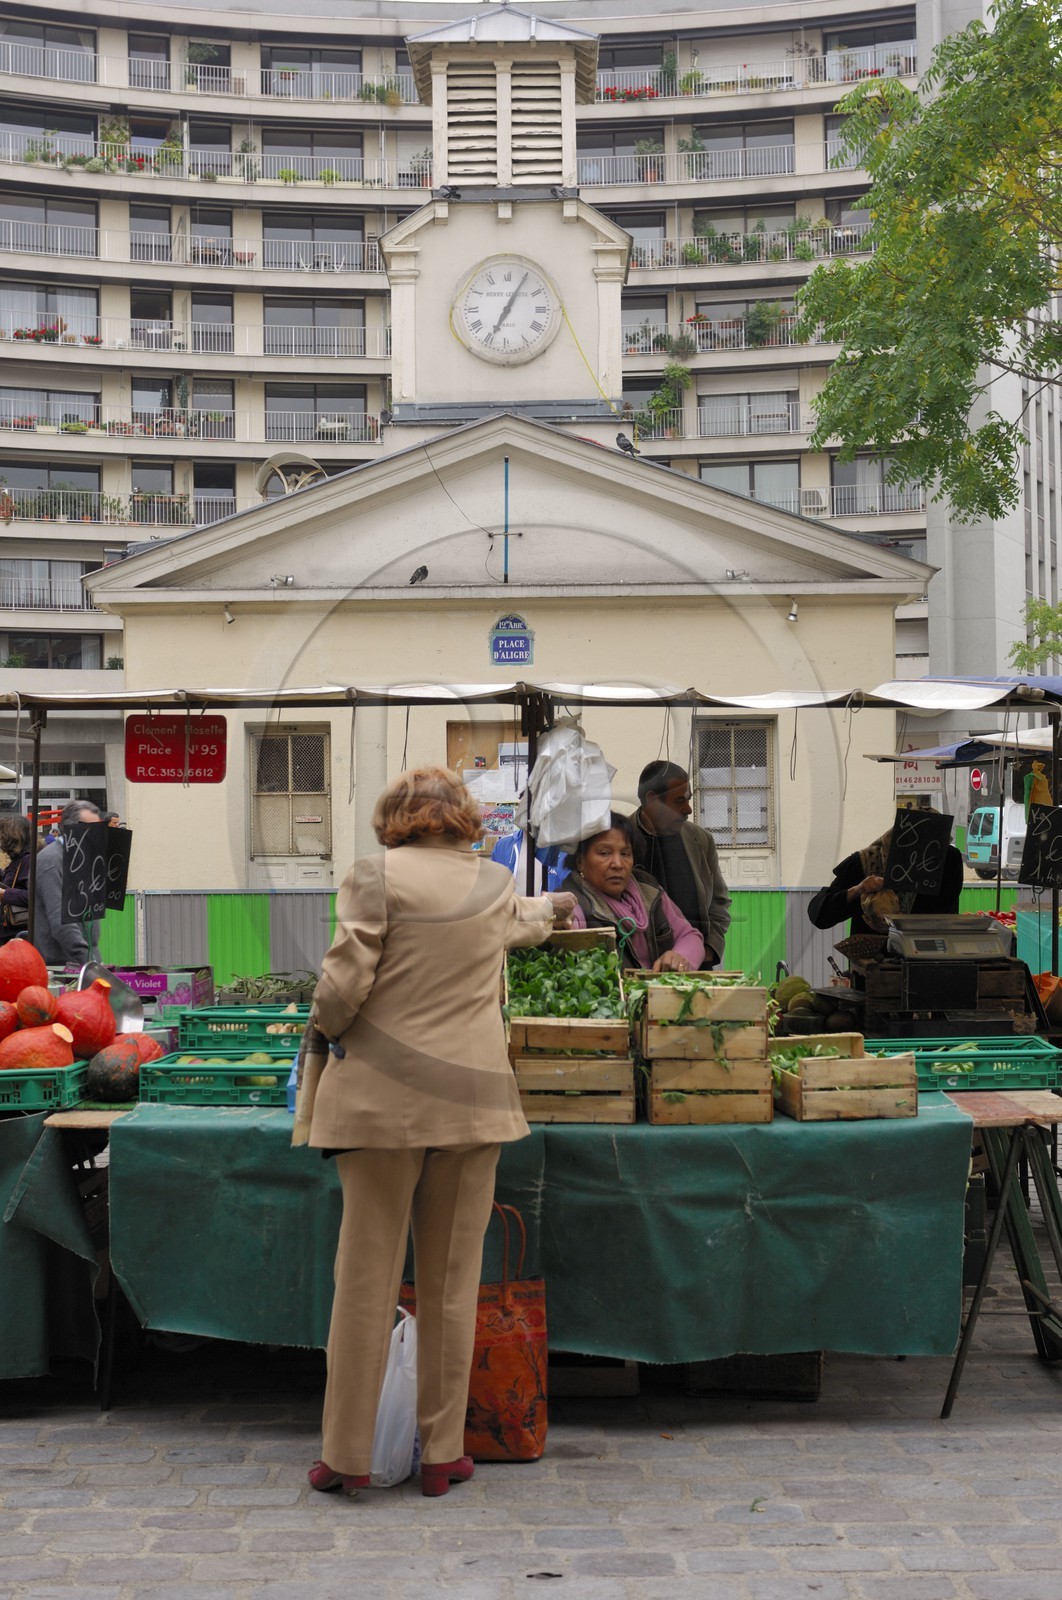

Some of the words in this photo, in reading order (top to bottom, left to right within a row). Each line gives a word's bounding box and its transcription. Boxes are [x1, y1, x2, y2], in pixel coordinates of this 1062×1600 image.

[498, 639, 525, 648] PLACE
[493, 650, 530, 659] D'ALIGRE
[138, 744, 172, 755] Place
[201, 744, 218, 756] 95
[135, 979, 161, 988] Violet
